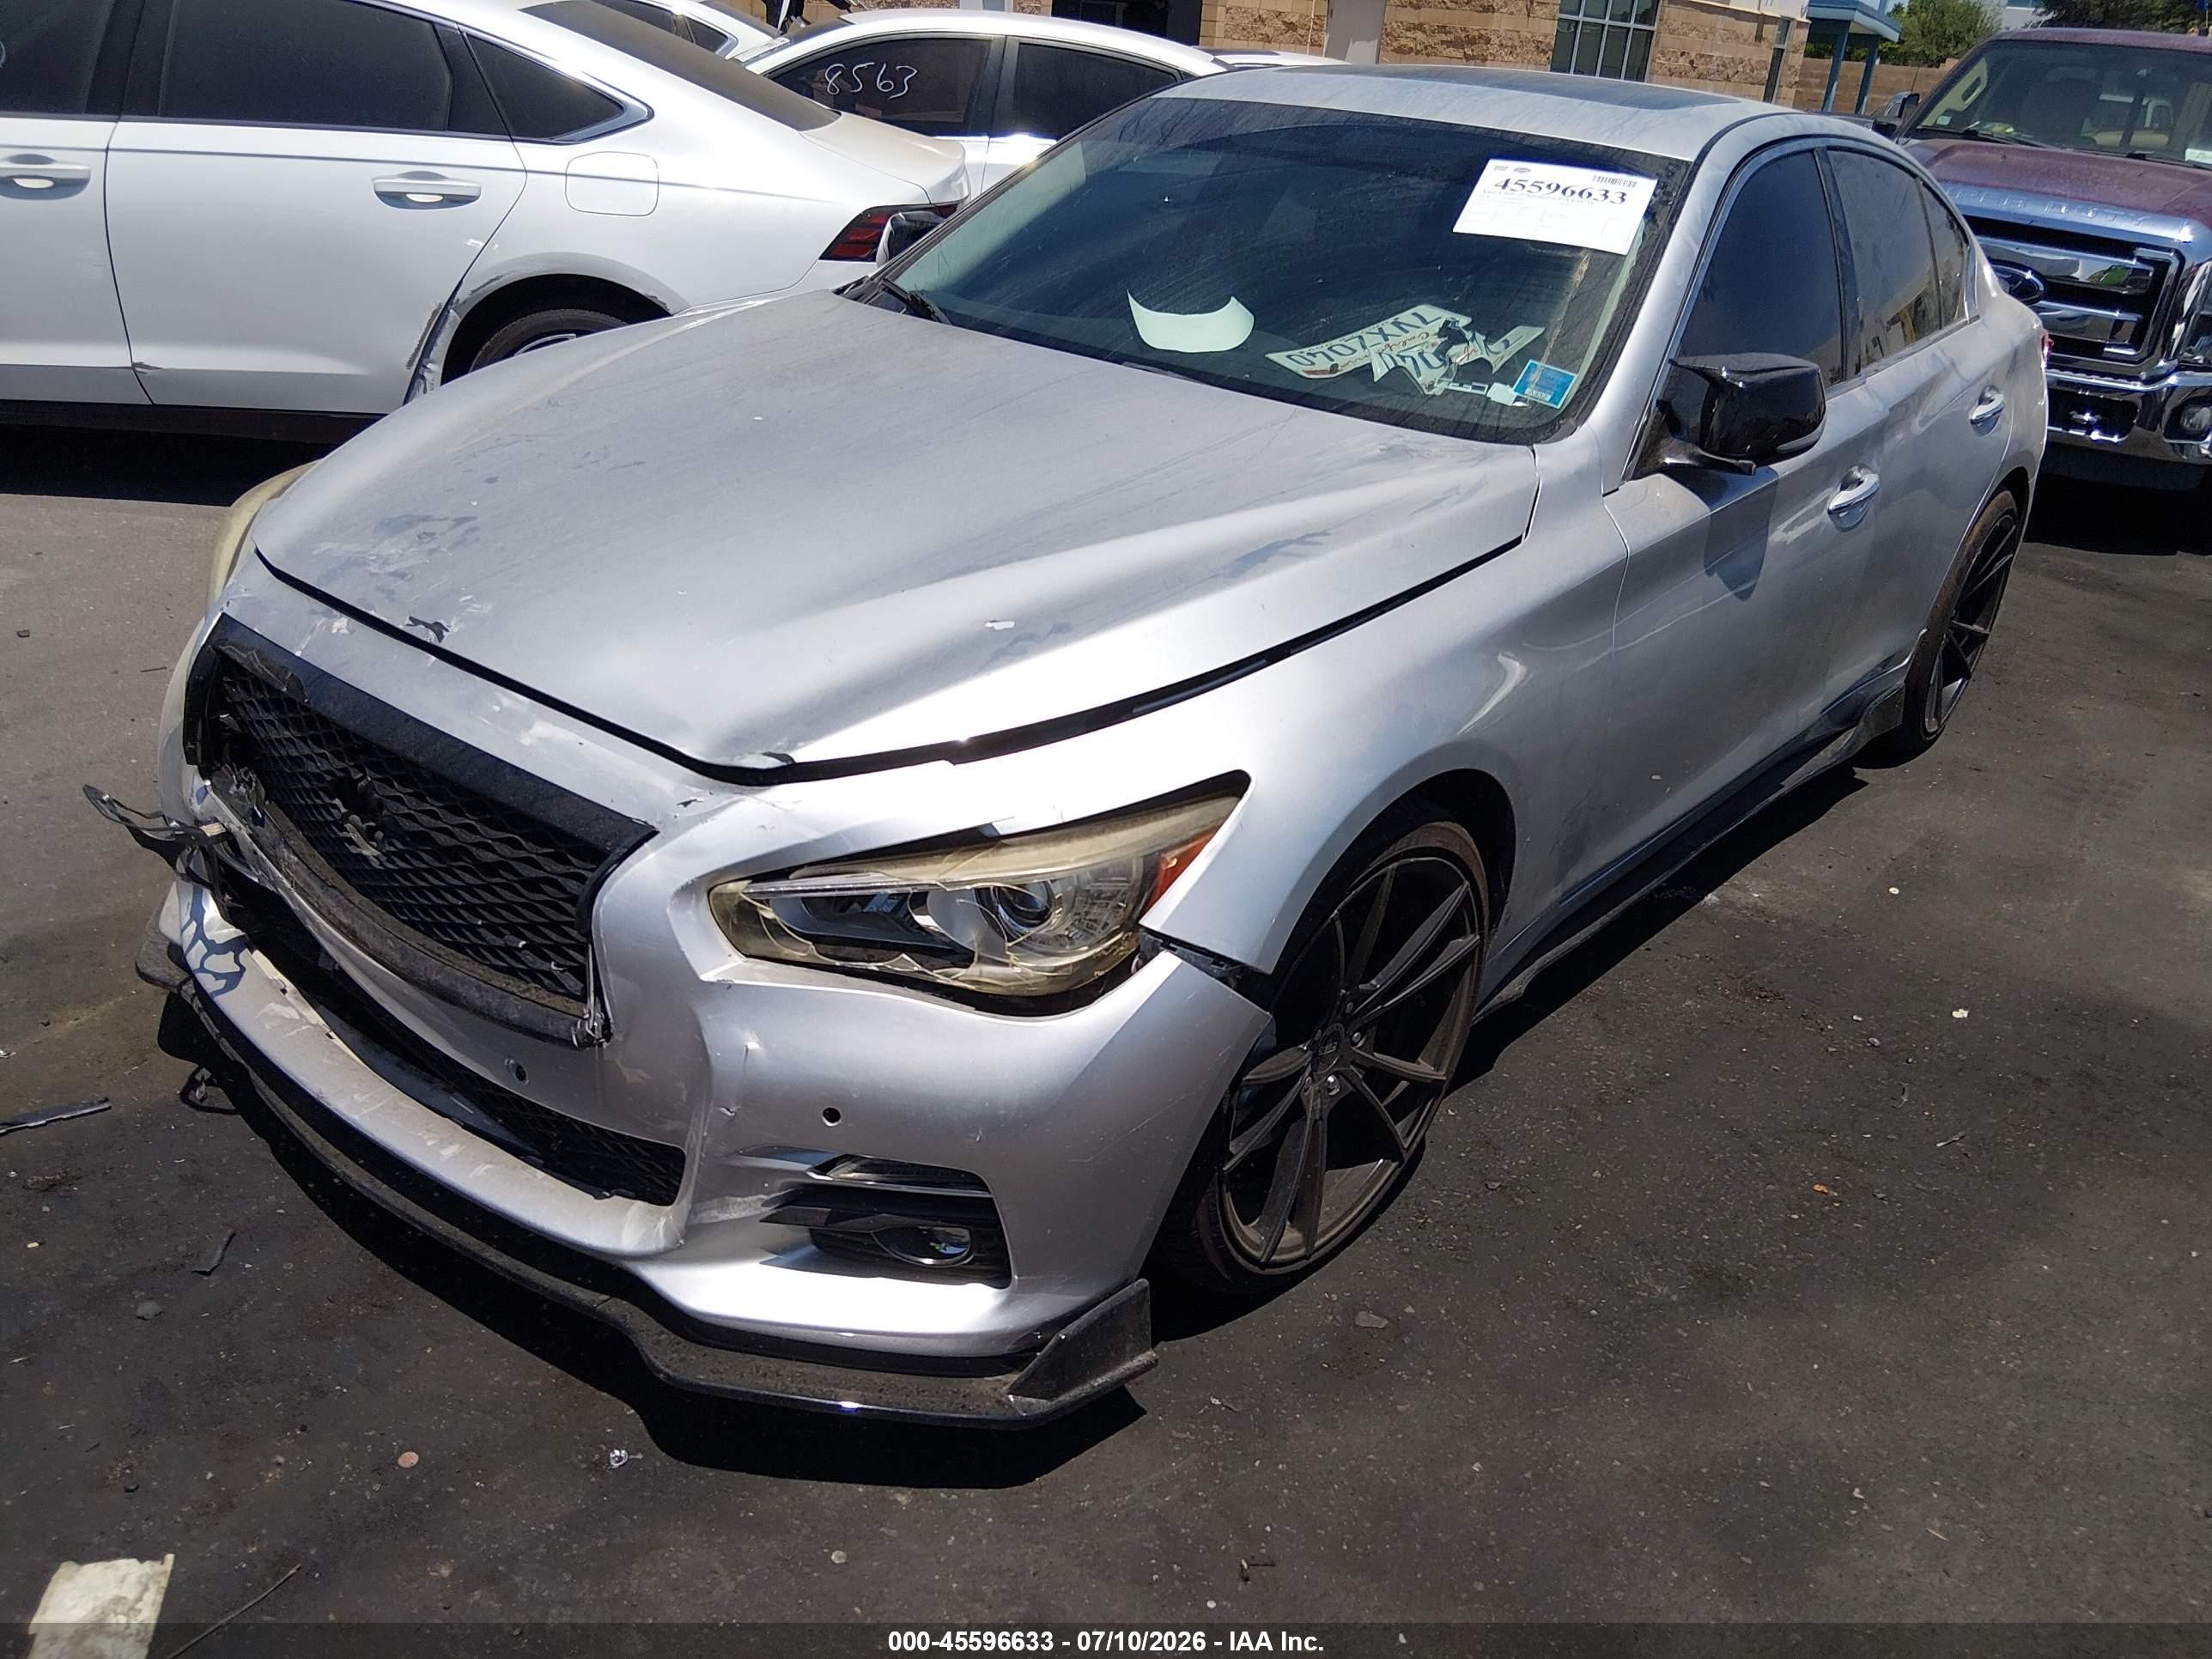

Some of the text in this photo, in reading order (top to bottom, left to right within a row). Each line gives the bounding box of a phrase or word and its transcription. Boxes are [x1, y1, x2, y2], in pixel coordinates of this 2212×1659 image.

[824, 62, 919, 100] 8563
[1494, 177, 1627, 205] 45596633
[1285, 310, 1444, 367] 7VXZ040
